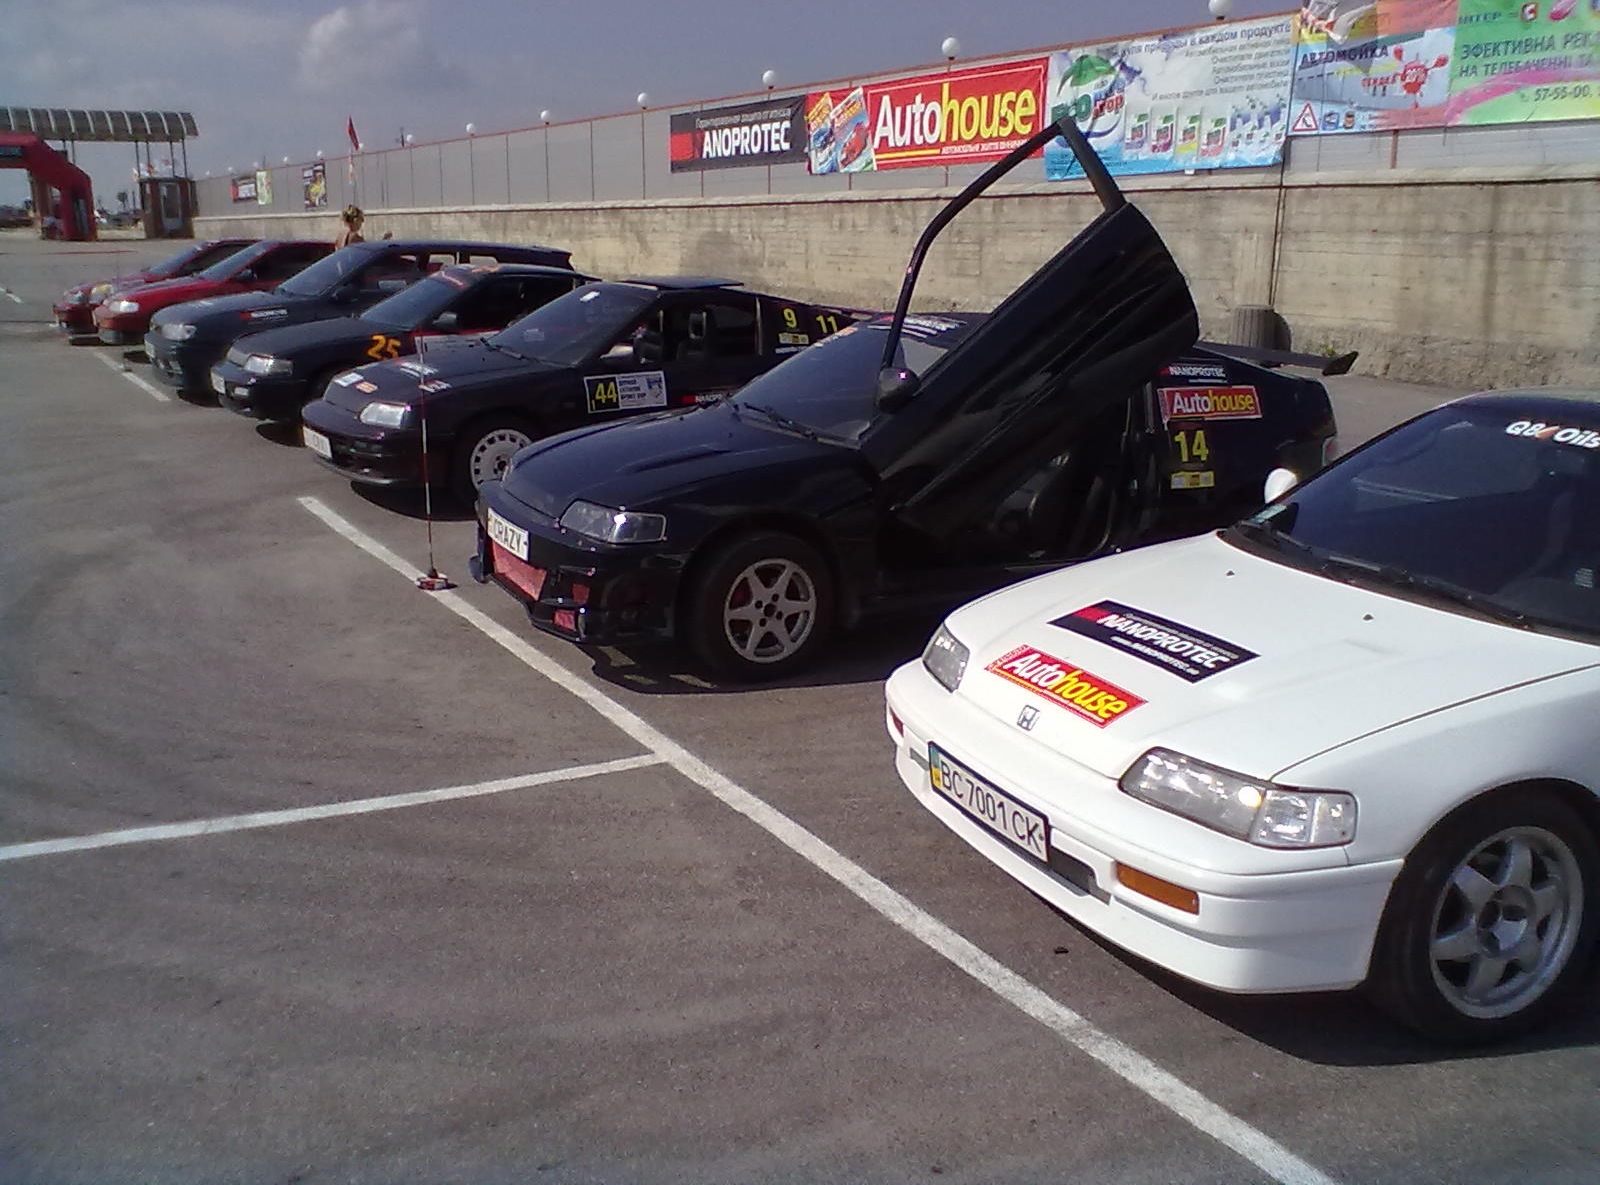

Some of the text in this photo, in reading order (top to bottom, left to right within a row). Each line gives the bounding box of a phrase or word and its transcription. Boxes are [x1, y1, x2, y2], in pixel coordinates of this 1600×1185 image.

[1240, 22, 1291, 40] продукте
[1460, 65, 1478, 77] НА
[874, 81, 1037, 149] Autohouse
[697, 121, 791, 160] ANOPROTEC
[783, 308, 797, 329] 9
[815, 315, 838, 334] 11
[367, 334, 401, 360] 25
[595, 381, 618, 404] 44
[1172, 389, 1255, 414] Autohouse
[1174, 430, 1209, 462] 14
[1553, 428, 1600, 449] Oils
[1096, 613, 1230, 669] NANOPROTEC
[1002, 652, 1128, 718] Autohouse
